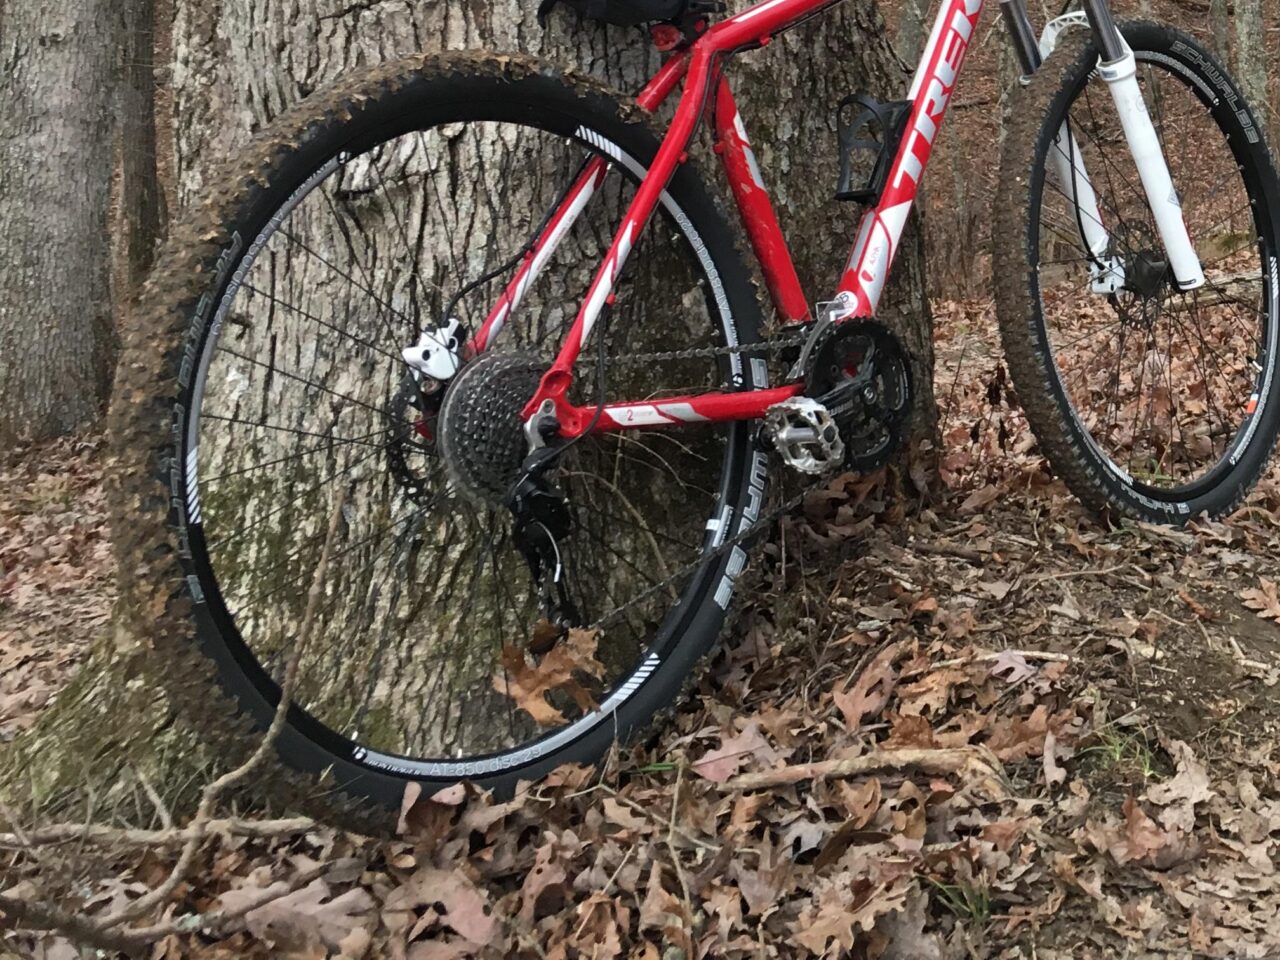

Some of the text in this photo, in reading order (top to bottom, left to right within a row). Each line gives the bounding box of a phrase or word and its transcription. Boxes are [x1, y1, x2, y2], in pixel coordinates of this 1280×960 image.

[1169, 41, 1260, 143] SCHWALBE
[676, 212, 692, 231] 29
[429, 762, 485, 776] AT-850
[489, 756, 520, 771] disc
[523, 746, 542, 761] 29
